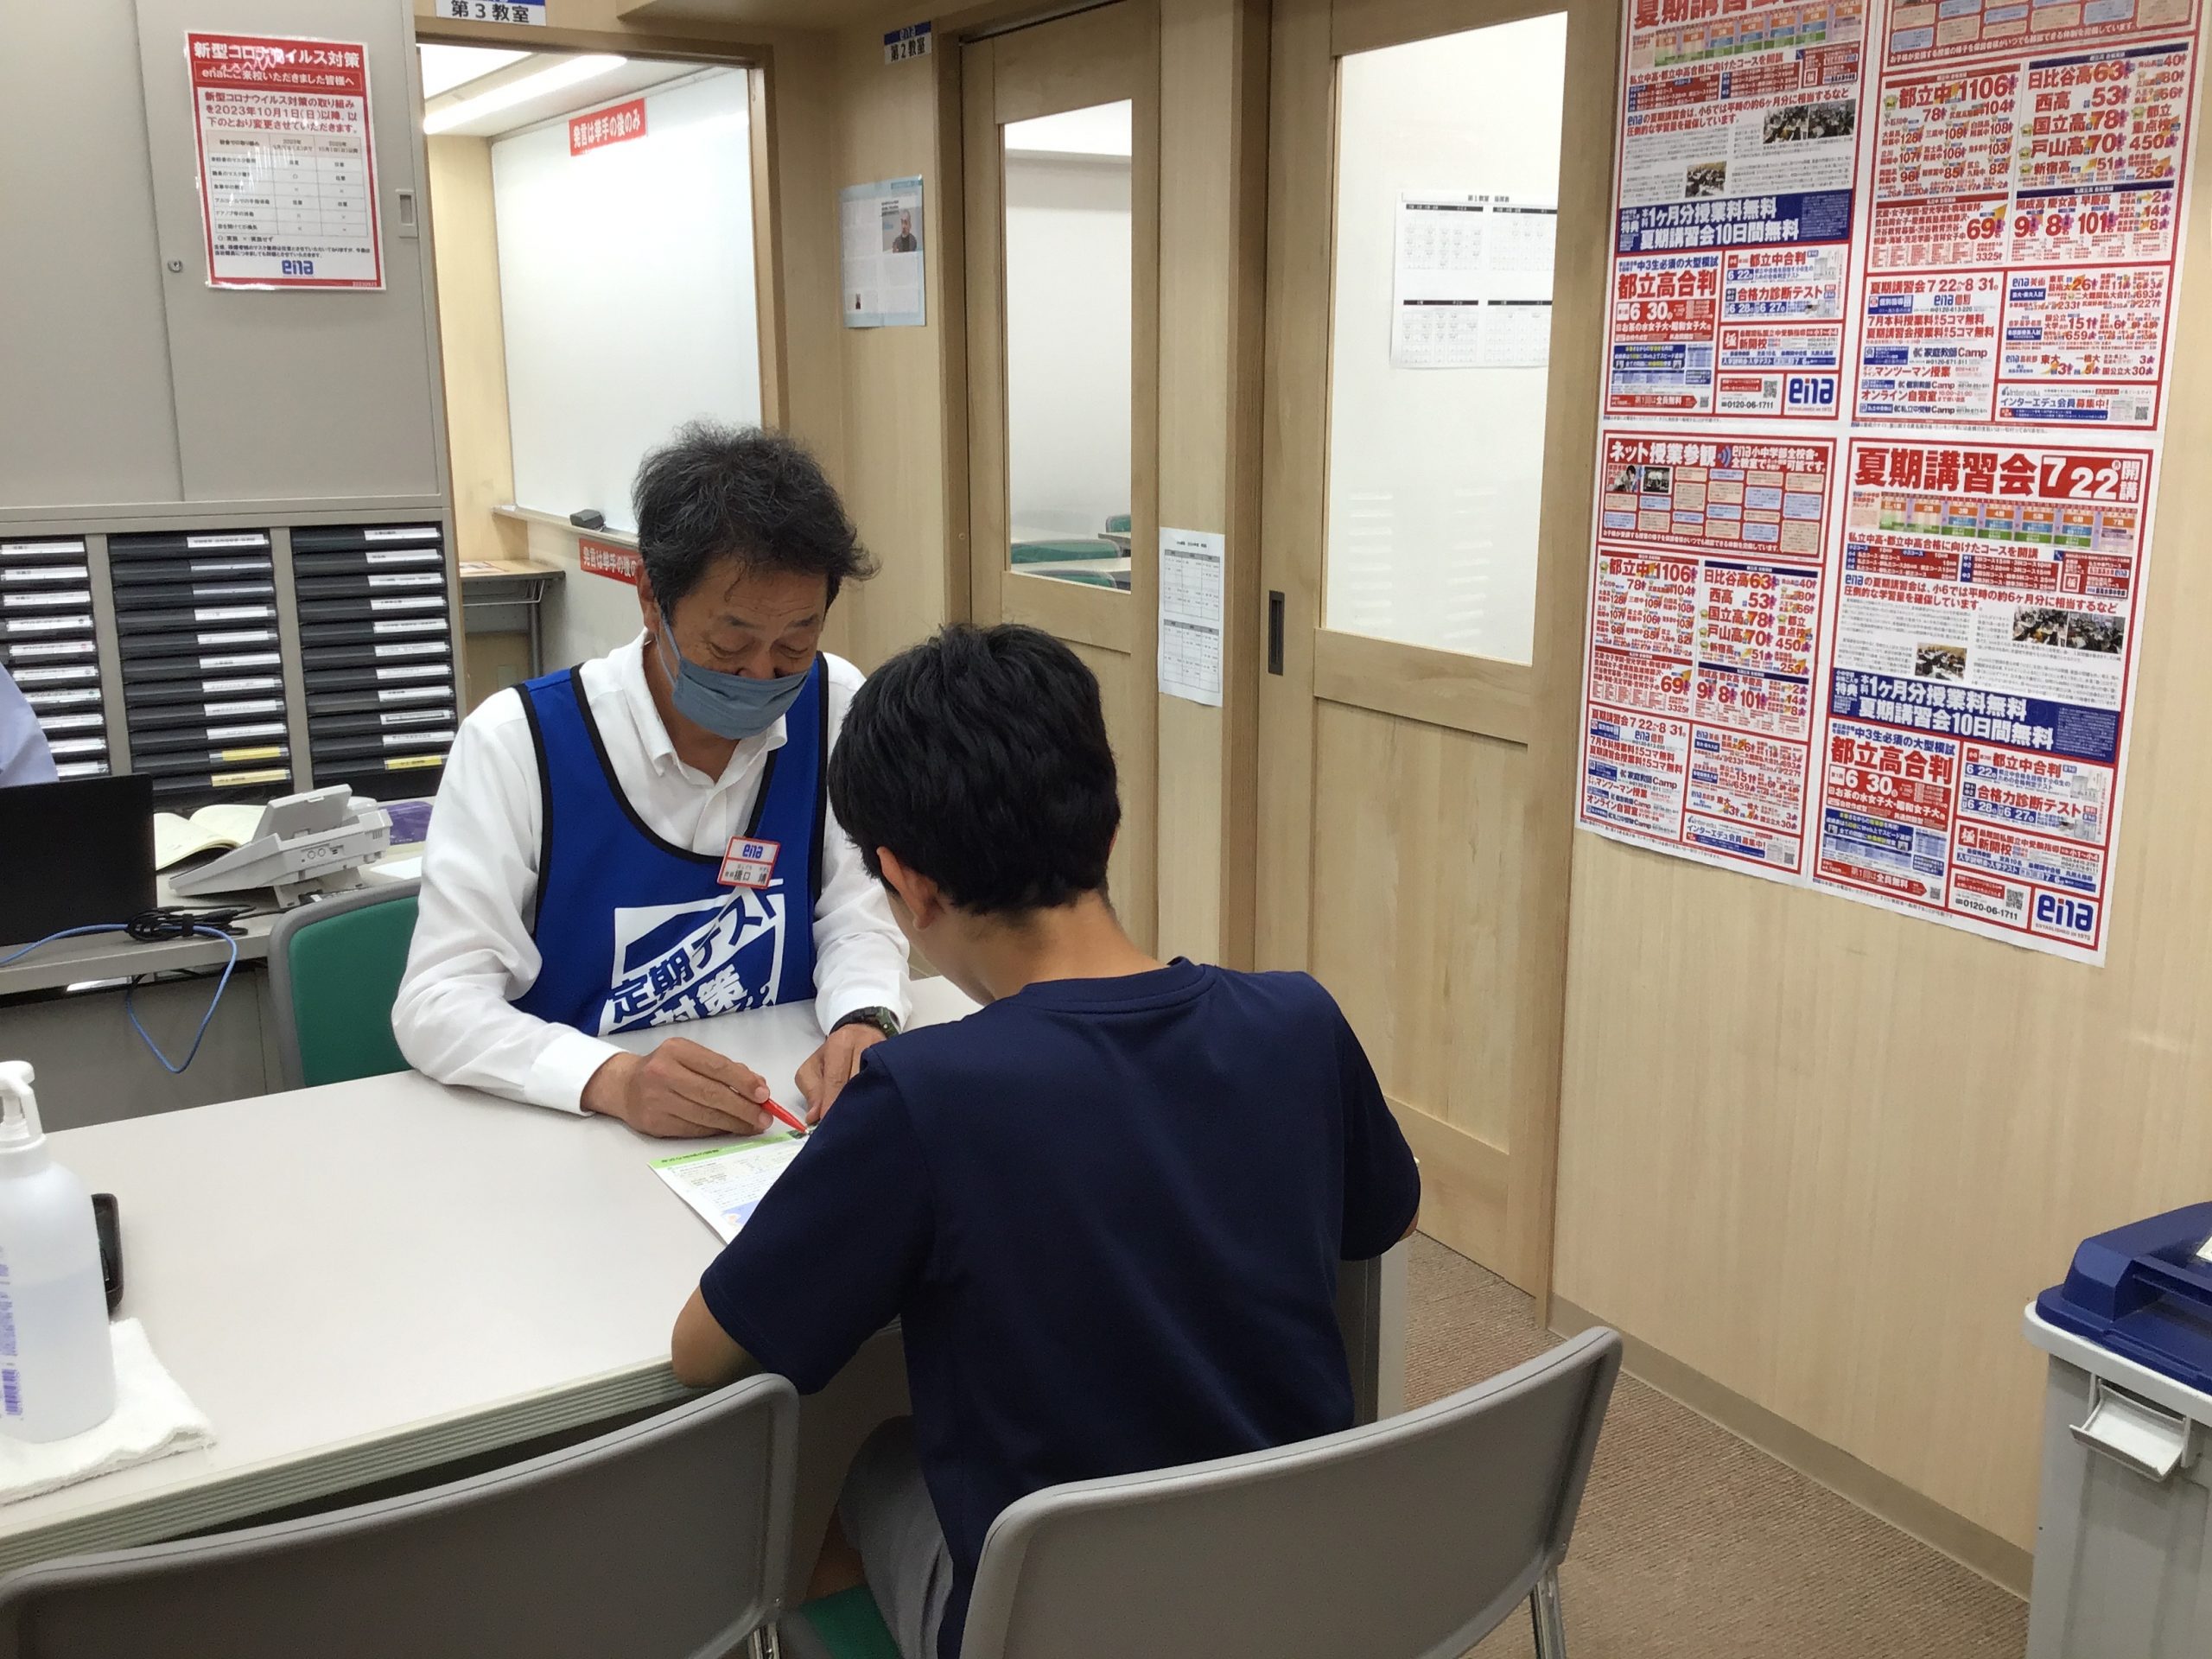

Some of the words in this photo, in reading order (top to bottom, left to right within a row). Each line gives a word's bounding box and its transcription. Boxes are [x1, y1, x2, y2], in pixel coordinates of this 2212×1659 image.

[451, 0, 529, 22] 第3教室
[2164, 54, 2181, 67] 40
[2028, 65, 2093, 89] 日比谷高
[2094, 60, 2125, 82] 63
[205, 92, 354, 108] 新型コロナウイルス対策の取り組み
[1899, 84, 1951, 109] 都立中
[1959, 74, 2008, 101] 1106
[2036, 91, 2071, 112] 西高
[2092, 86, 2122, 107] 53
[1923, 108, 1941, 122] 78
[1984, 100, 2009, 115] 104
[574, 108, 640, 148] 発言は挙手の後のみ
[2033, 113, 2087, 136] 国立高
[2092, 109, 2119, 130] 78
[1901, 132, 1917, 143] 128
[1945, 127, 1962, 140] 109
[2129, 134, 2164, 150] 450
[1943, 147, 1961, 159] 106
[2031, 137, 2084, 157] 戸山高
[2088, 133, 2118, 154] 70
[1900, 151, 1916, 163] 107
[2034, 161, 2071, 175] 新宿高
[2096, 157, 2113, 170] 51
[1901, 171, 1915, 182] 96
[1944, 168, 1959, 179] 85
[1989, 162, 2005, 175] 82
[1967, 218, 1995, 240] 69
[2014, 216, 2029, 238] 9
[2045, 214, 2063, 236] 8
[2078, 212, 2107, 234] 101
[1641, 219, 1799, 251] 夏期講習会10日間無料
[1637, 256, 1719, 271] 中3生必須の大型模試
[1750, 251, 1806, 266] 都立中合判
[1976, 252, 1999, 261] 3325
[282, 259, 314, 275] ena
[1618, 270, 1716, 299] 都立高合判
[1738, 285, 1822, 301] 合格力診断テスト
[1871, 280, 1926, 295] 夏期講習会
[1927, 280, 1936, 292] 7
[1978, 277, 1994, 291] 31
[1630, 303, 1640, 320] 6
[1647, 302, 1669, 320] 30
[1924, 347, 1987, 359] 家庭教師Camp
[2041, 354, 2060, 364] 東大
[1876, 366, 1951, 378] マンツーマン授業
[2133, 366, 2145, 375] 30
[1789, 378, 1834, 404] ena
[1861, 391, 1936, 402] オンライン自習室
[1728, 400, 1773, 409] 0120-06-1711
[2000, 398, 2109, 409] インターエデュ会員募集中!
[1610, 442, 1717, 467] ネット授業参観
[1855, 447, 2037, 495] 夏期講習会
[2043, 457, 2067, 487] 7
[2069, 467, 2119, 499] 22
[2119, 460, 2141, 501] 開講
[1848, 532, 2038, 559] 私立中高・都立中高合格に向けたコースを開講
[583, 546, 637, 577] 発言は挙手の後の
[1610, 558, 1650, 578] 都立中
[1654, 563, 1691, 583] 1106
[1627, 579, 1642, 590] 78
[1704, 569, 1749, 588] 日比谷高
[1750, 573, 1771, 589] 63
[1800, 579, 1812, 588] 40
[1710, 588, 1733, 604] 西高
[1749, 592, 1770, 609] 53
[1844, 586, 1982, 610] 圧倒的な学習量を確保しています。
[1845, 574, 2118, 613] enaの夏期講習会は、小6では平時の約6ヶ月分に相当するなど
[1708, 606, 1745, 625] 国立高
[1747, 611, 1769, 627] 78
[1707, 624, 1743, 643] 戸山高
[1745, 629, 1766, 645] 70
[1751, 650, 1764, 659] 51
[1776, 639, 1801, 652] 450
[1661, 676, 1683, 694] 69
[1836, 683, 1857, 696] 特典
[1697, 682, 1708, 699] 9
[1719, 686, 1729, 702] 8
[1741, 690, 1761, 709] 101
[1859, 696, 2054, 750] 夏期講習会10日間無料
[1855, 728, 1955, 756] 中3生必須の大型模試
[1830, 735, 1954, 785] 都立高合判
[1993, 753, 2062, 778] 都立中合判
[1967, 765, 1974, 773] 6
[1978, 766, 1992, 777] 22
[1846, 770, 1859, 788] 6
[1866, 774, 1892, 795] 30
[1587, 795, 1639, 816] オンライン自習室
[1835, 788, 1940, 818] お茶の水女子大・昭和女子大
[1967, 799, 1974, 809] 6
[1978, 802, 1993, 811] 28
[1977, 785, 2081, 817] 合格力診断テスト
[2004, 807, 2012, 816] 6
[2016, 810, 2029, 821] 27
[1687, 825, 1766, 849] インターエデュ会員募集中!
[742, 844, 763, 858] ena
[1979, 838, 2012, 856] 新開校
[1963, 899, 2018, 920] 0120-06-1711
[2037, 893, 2094, 932] ena
